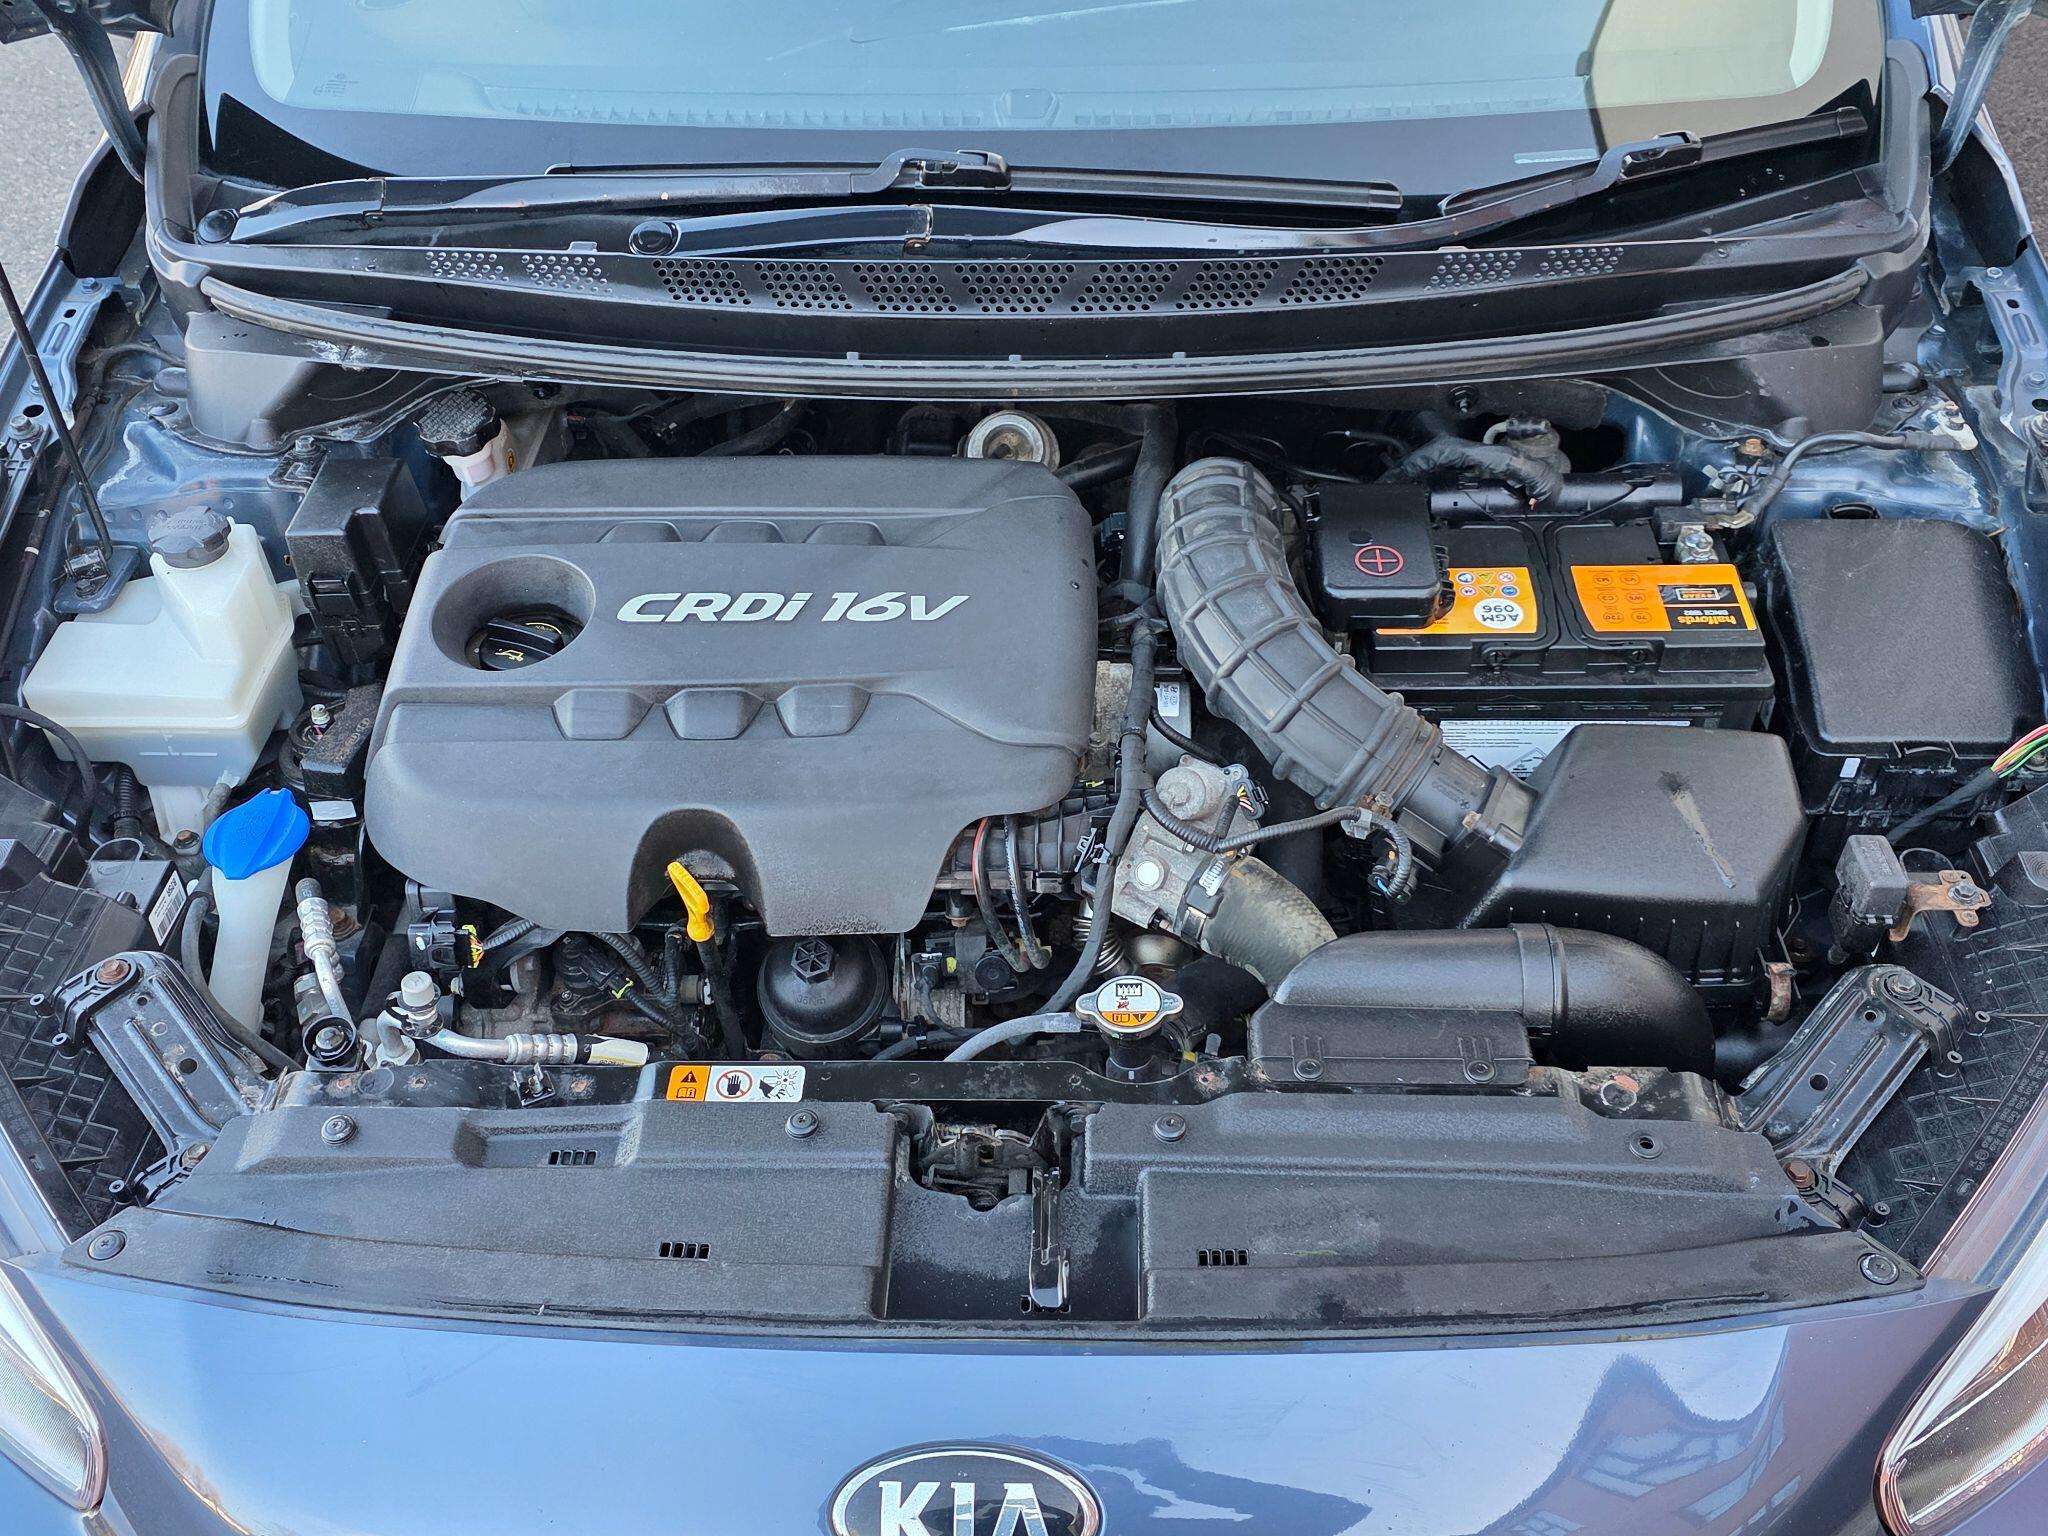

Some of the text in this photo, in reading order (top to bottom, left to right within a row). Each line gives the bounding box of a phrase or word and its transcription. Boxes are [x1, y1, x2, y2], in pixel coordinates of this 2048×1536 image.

[616, 591, 971, 623] CRDi 16V
[1482, 604, 1514, 613] 096
[1481, 613, 1519, 622] AGM
[1676, 615, 1737, 625] halfords
[878, 1480, 1050, 1536] KIA
